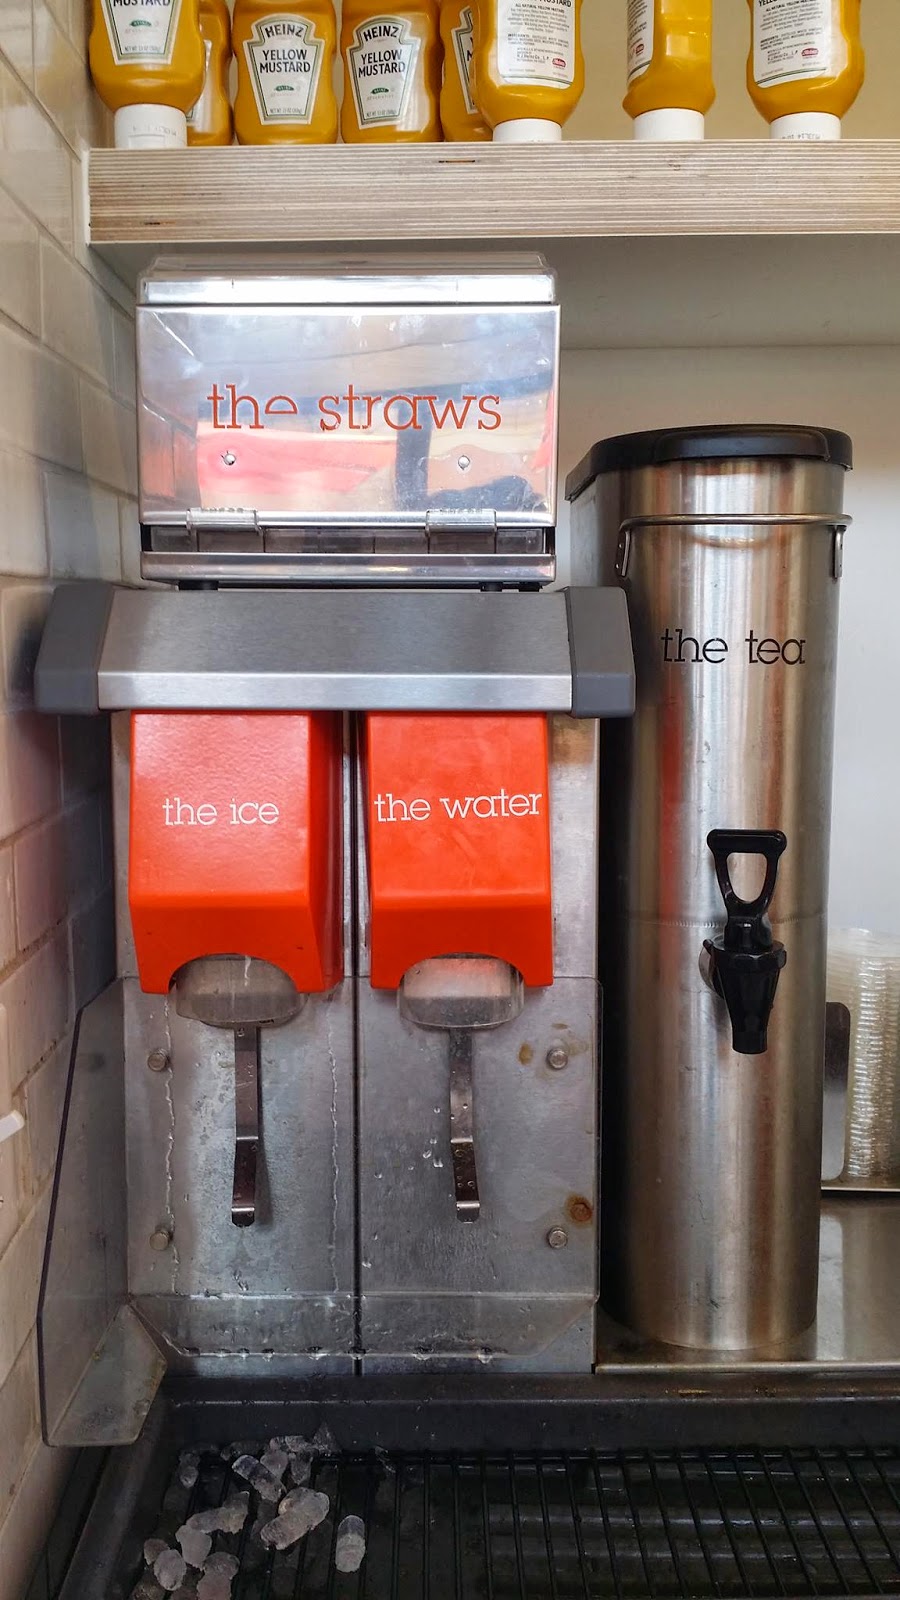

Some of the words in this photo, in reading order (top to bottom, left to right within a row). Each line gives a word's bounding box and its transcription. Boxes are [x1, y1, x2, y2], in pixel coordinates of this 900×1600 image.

[264, 24, 304, 37] HEINZ
[363, 25, 400, 42] HEINZ
[262, 49, 307, 61] YELLOW
[361, 49, 403, 65] YELLOW
[259, 61, 311, 74] MUSTARD
[358, 61, 406, 78] MUSTARD
[207, 383, 298, 429] the
[318, 384, 502, 432] straws
[661, 628, 729, 664] the
[744, 630, 806, 665] tea
[162, 797, 218, 825] the
[229, 797, 280, 825] ice
[374, 793, 431, 822] the
[439, 788, 543, 819] water
